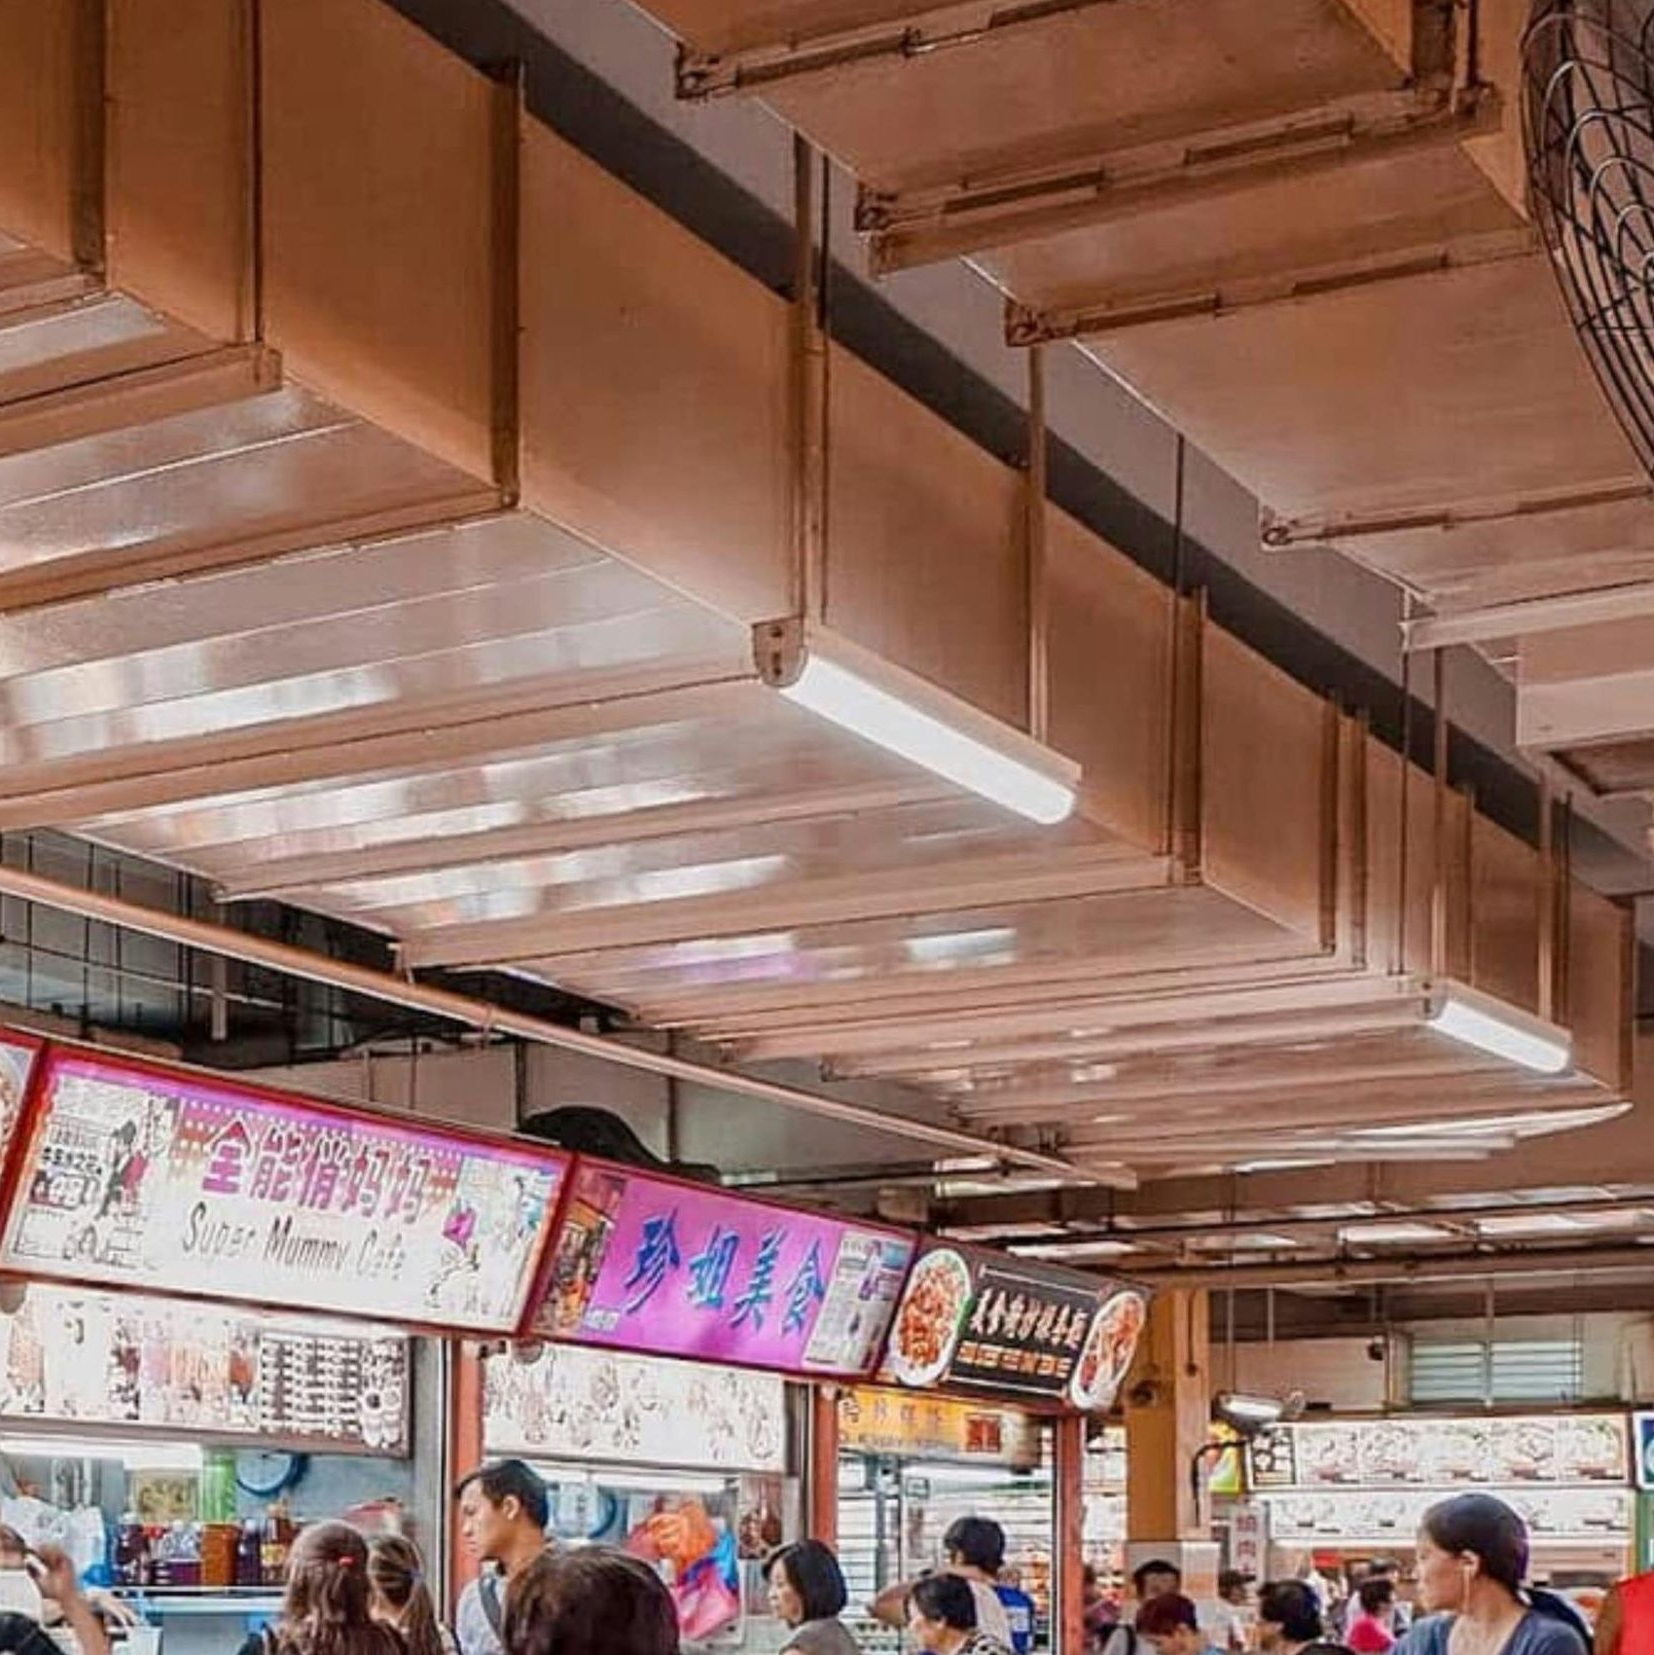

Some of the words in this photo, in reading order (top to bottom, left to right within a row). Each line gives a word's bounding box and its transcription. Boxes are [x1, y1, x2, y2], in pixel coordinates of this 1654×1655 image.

[203, 1119, 431, 1223] 全能俏妈妈
[183, 1200, 257, 1263] Super
[263, 1216, 349, 1271] Mummy
